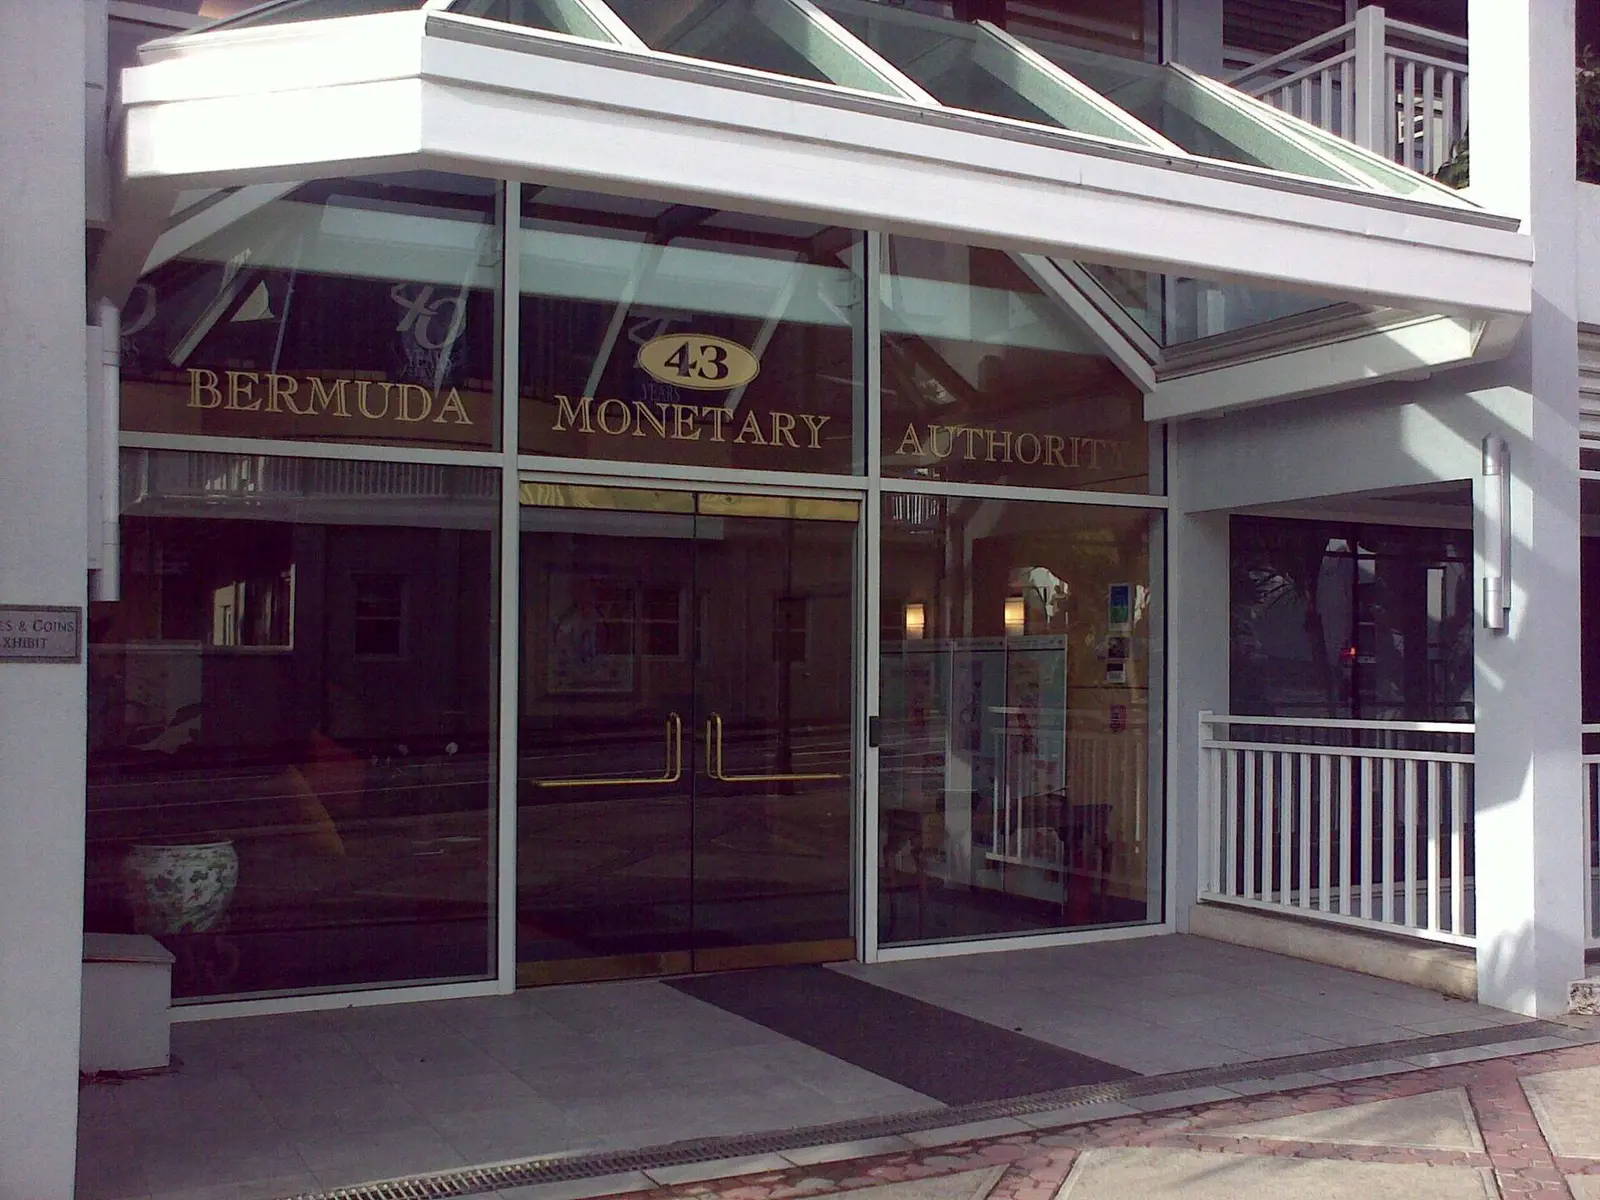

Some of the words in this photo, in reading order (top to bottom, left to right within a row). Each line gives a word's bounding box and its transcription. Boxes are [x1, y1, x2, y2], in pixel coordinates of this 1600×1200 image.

[663, 340, 729, 380] 43
[186, 367, 475, 426] BERMUDA
[551, 393, 832, 450] MONETARY
[895, 421, 1130, 471] AUTHORITY
[18, 620, 28, 632] &
[33, 619, 75, 633] COINS
[0, 636, 48, 649] XHIBIT
